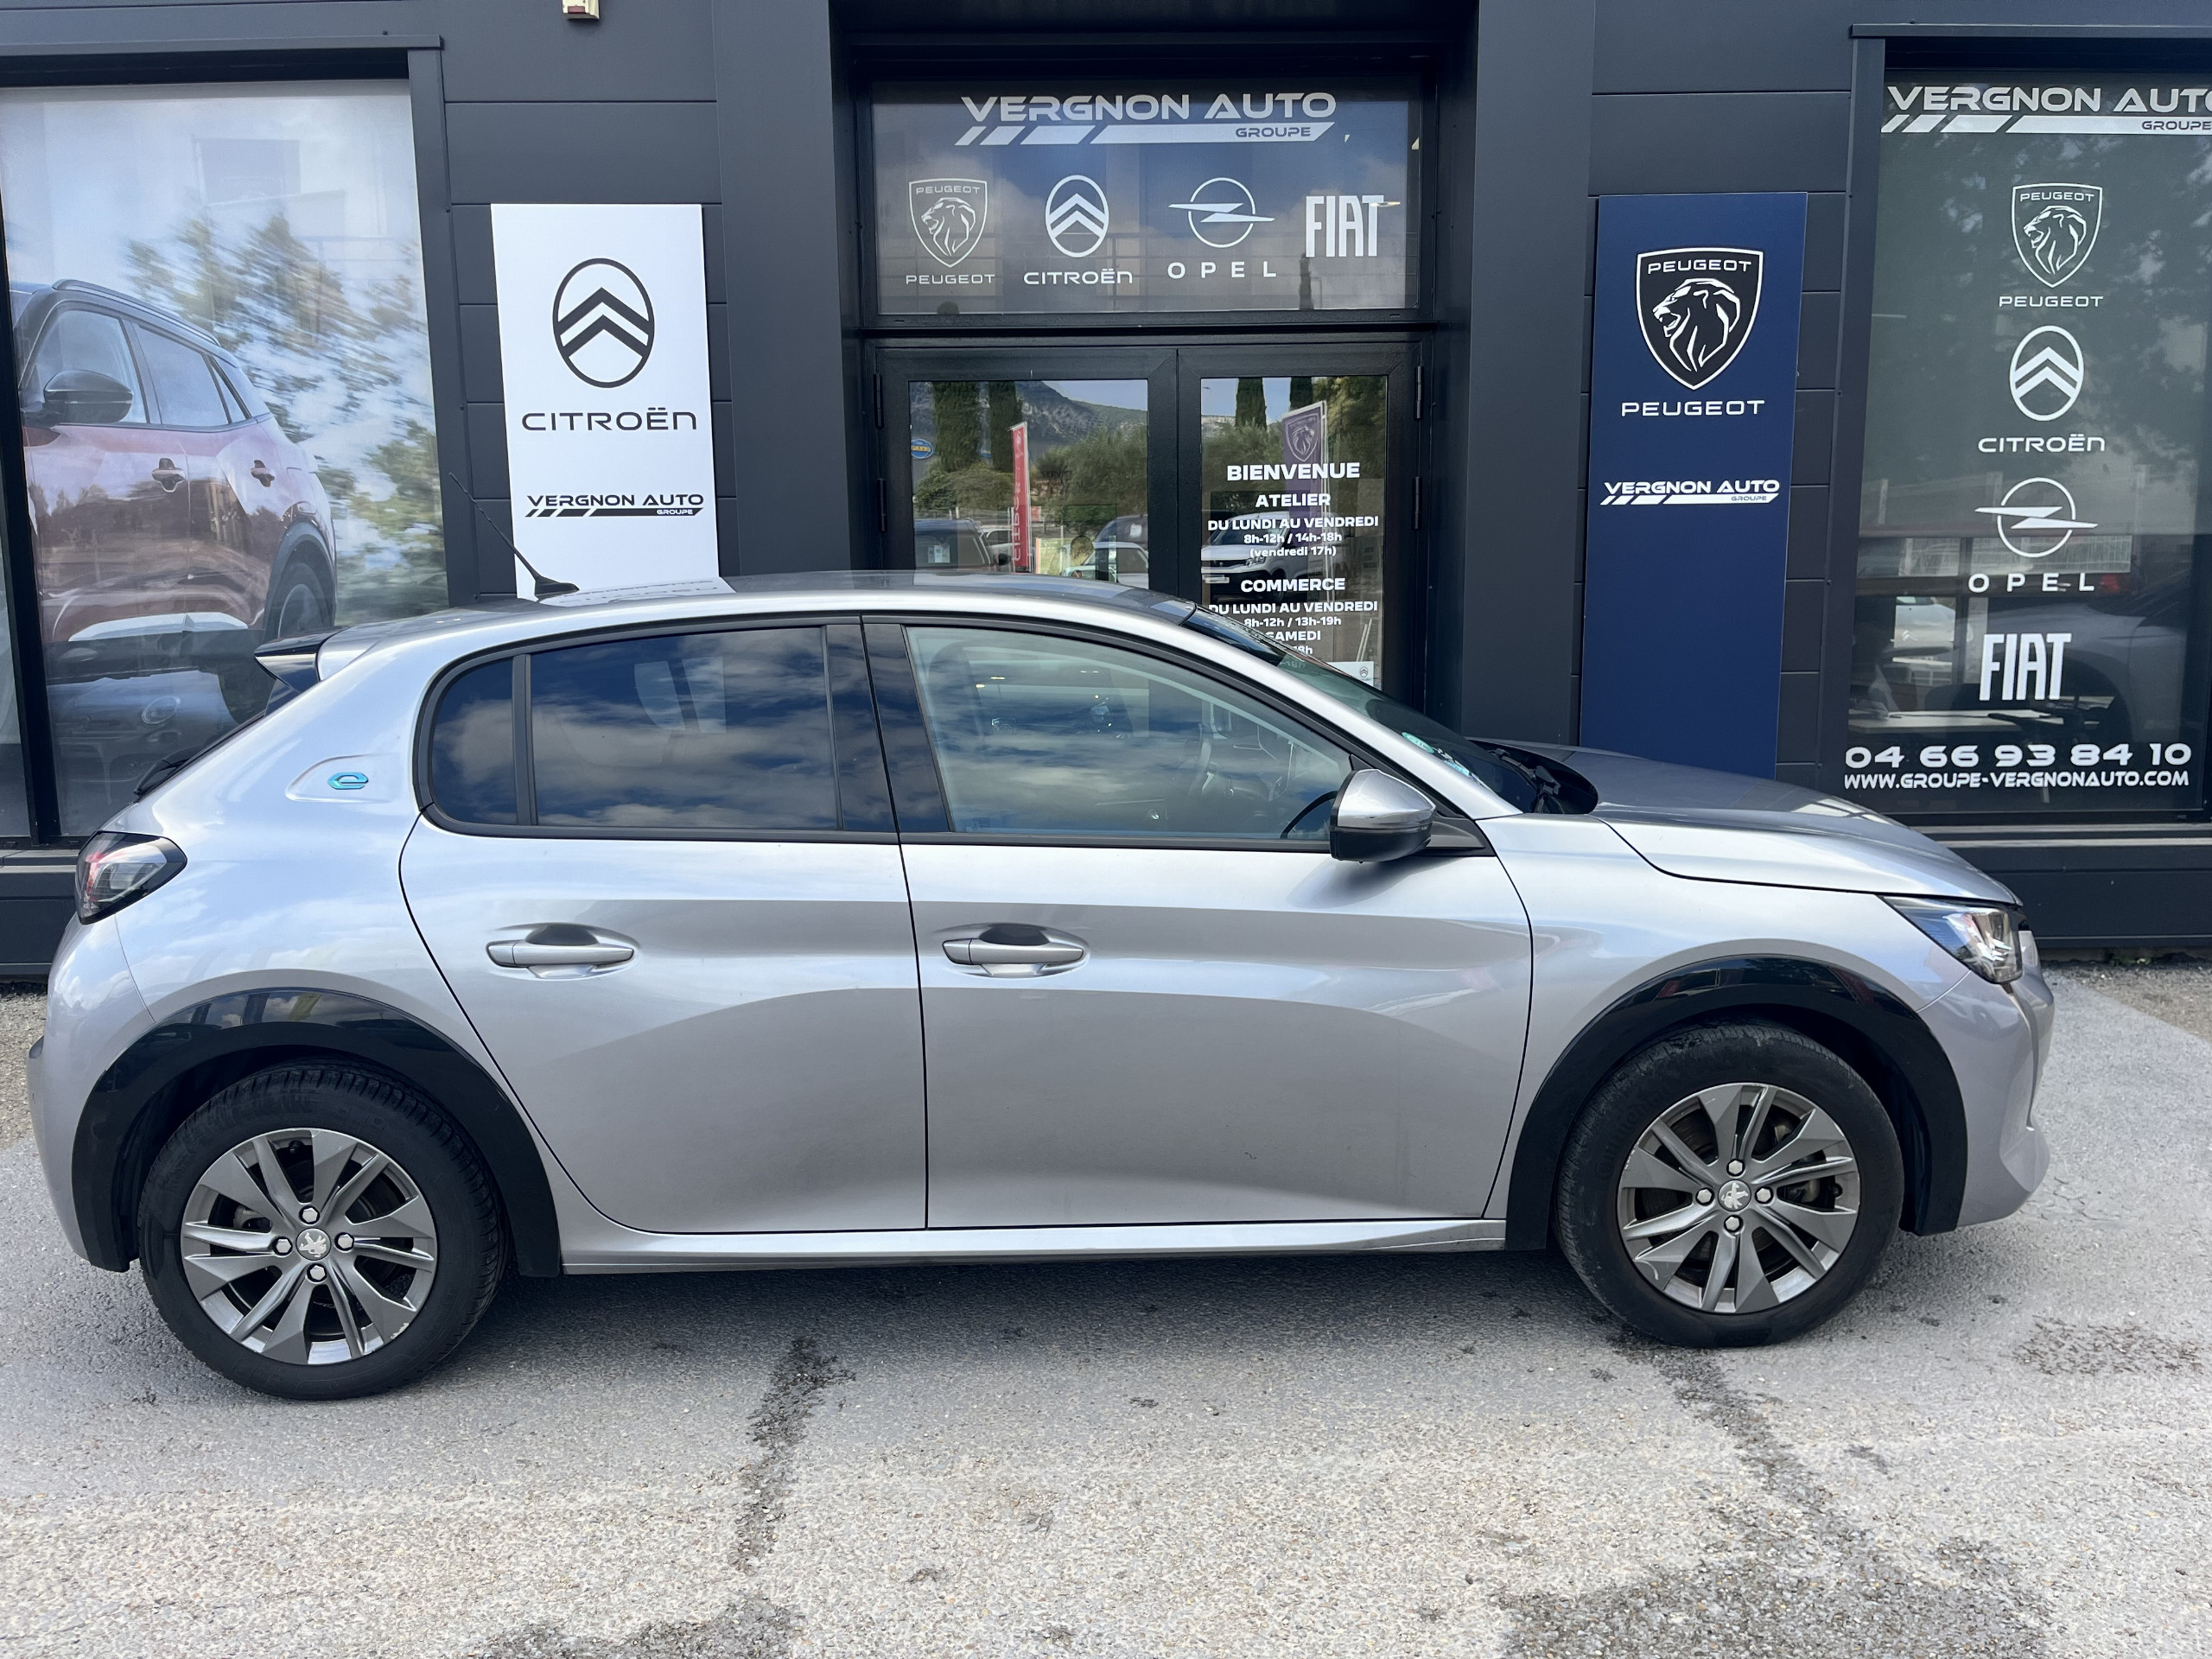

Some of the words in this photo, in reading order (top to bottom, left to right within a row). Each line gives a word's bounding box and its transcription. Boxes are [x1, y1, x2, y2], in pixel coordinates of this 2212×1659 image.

[1887, 86, 2101, 111] VERGNON
[2113, 88, 2212, 112] AUT
[962, 94, 1188, 121] VERGNON
[1205, 92, 1336, 118] AUTO
[1235, 126, 1311, 138] GROUPE
[2142, 120, 2211, 130] GROUPE
[916, 186, 980, 195] PEUGEOT
[2020, 192, 2094, 202] PEUGEOT
[1306, 195, 1384, 257] FIAT
[1167, 261, 1276, 280] OPEL
[1648, 260, 1751, 274] PEUGEOT
[906, 274, 995, 285] PEUGEOT
[1999, 296, 2103, 307] PEUGEOT
[1621, 400, 1764, 416] PEUGEOT
[1227, 462, 1360, 481] BIENVENUE
[1605, 481, 1711, 494] VERGNON
[1716, 480, 1780, 493] AUTO
[527, 494, 634, 506] VERGNON
[643, 494, 703, 505] AUTO
[1255, 493, 1331, 507] ATELIER
[1208, 520, 1230, 531] DU
[1232, 518, 1275, 530] LUNDI
[1280, 518, 1300, 529] AU
[1303, 516, 1378, 528] VENDREDI
[1244, 534, 1284, 543] 8h-12h
[1296, 532, 1342, 543] 14h-18h
[1250, 548, 1307, 558] (vendredi
[1311, 546, 1336, 556] 17h)
[1241, 578, 1345, 593] COMMERCE
[1968, 572, 2094, 593] OPEL
[1232, 603, 1275, 614] LUNDI
[1280, 603, 1300, 613] AU
[1304, 601, 1377, 613] VENDREDI
[1296, 617, 1342, 626] 13h-19h
[1979, 632, 2072, 701] FIAT
[1845, 746, 1904, 768] 04
[1920, 745, 1979, 767] 66
[1994, 744, 2056, 766] 93
[2070, 744, 2133, 766] 84
[2150, 743, 2192, 765] 10
